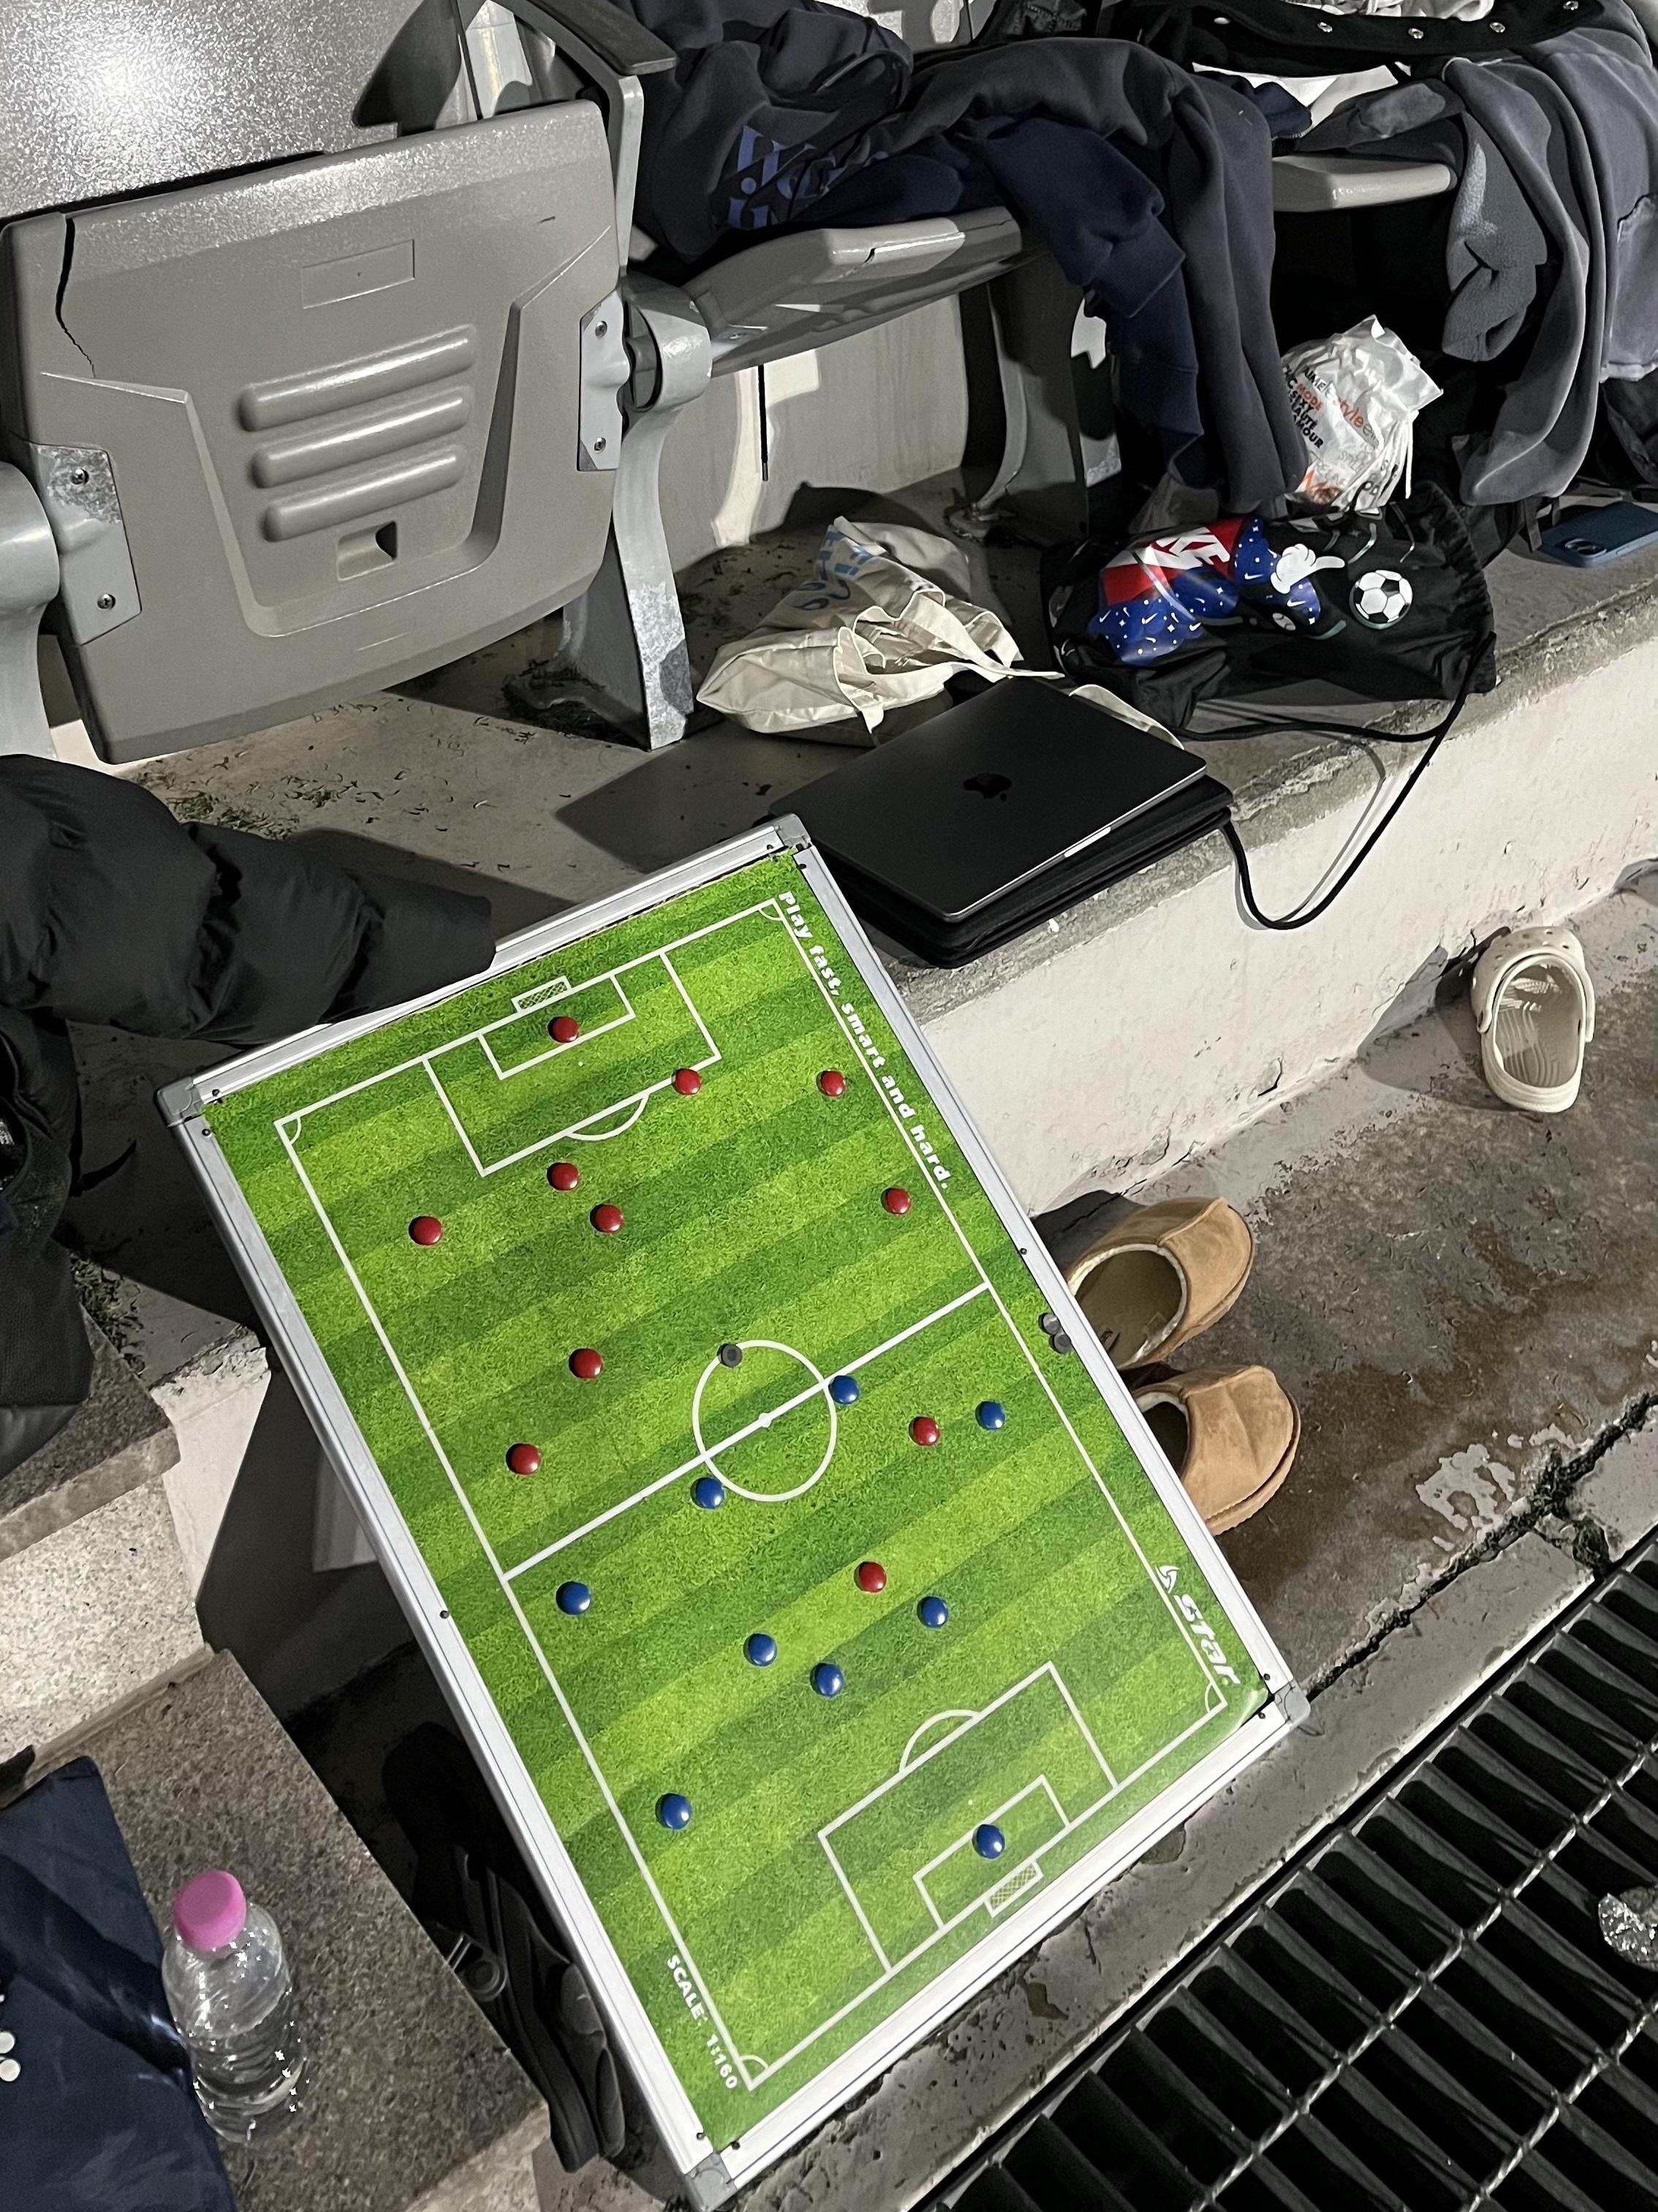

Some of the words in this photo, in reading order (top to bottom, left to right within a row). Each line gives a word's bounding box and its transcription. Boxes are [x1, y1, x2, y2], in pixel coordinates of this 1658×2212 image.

[778, 891, 814, 937] Play
[809, 945, 841, 996] fast,
[841, 1003, 885, 1068] smart
[882, 1075, 916, 1119] and
[910, 1124, 951, 1190] hard.
[706, 2034, 738, 2089] 1:160
